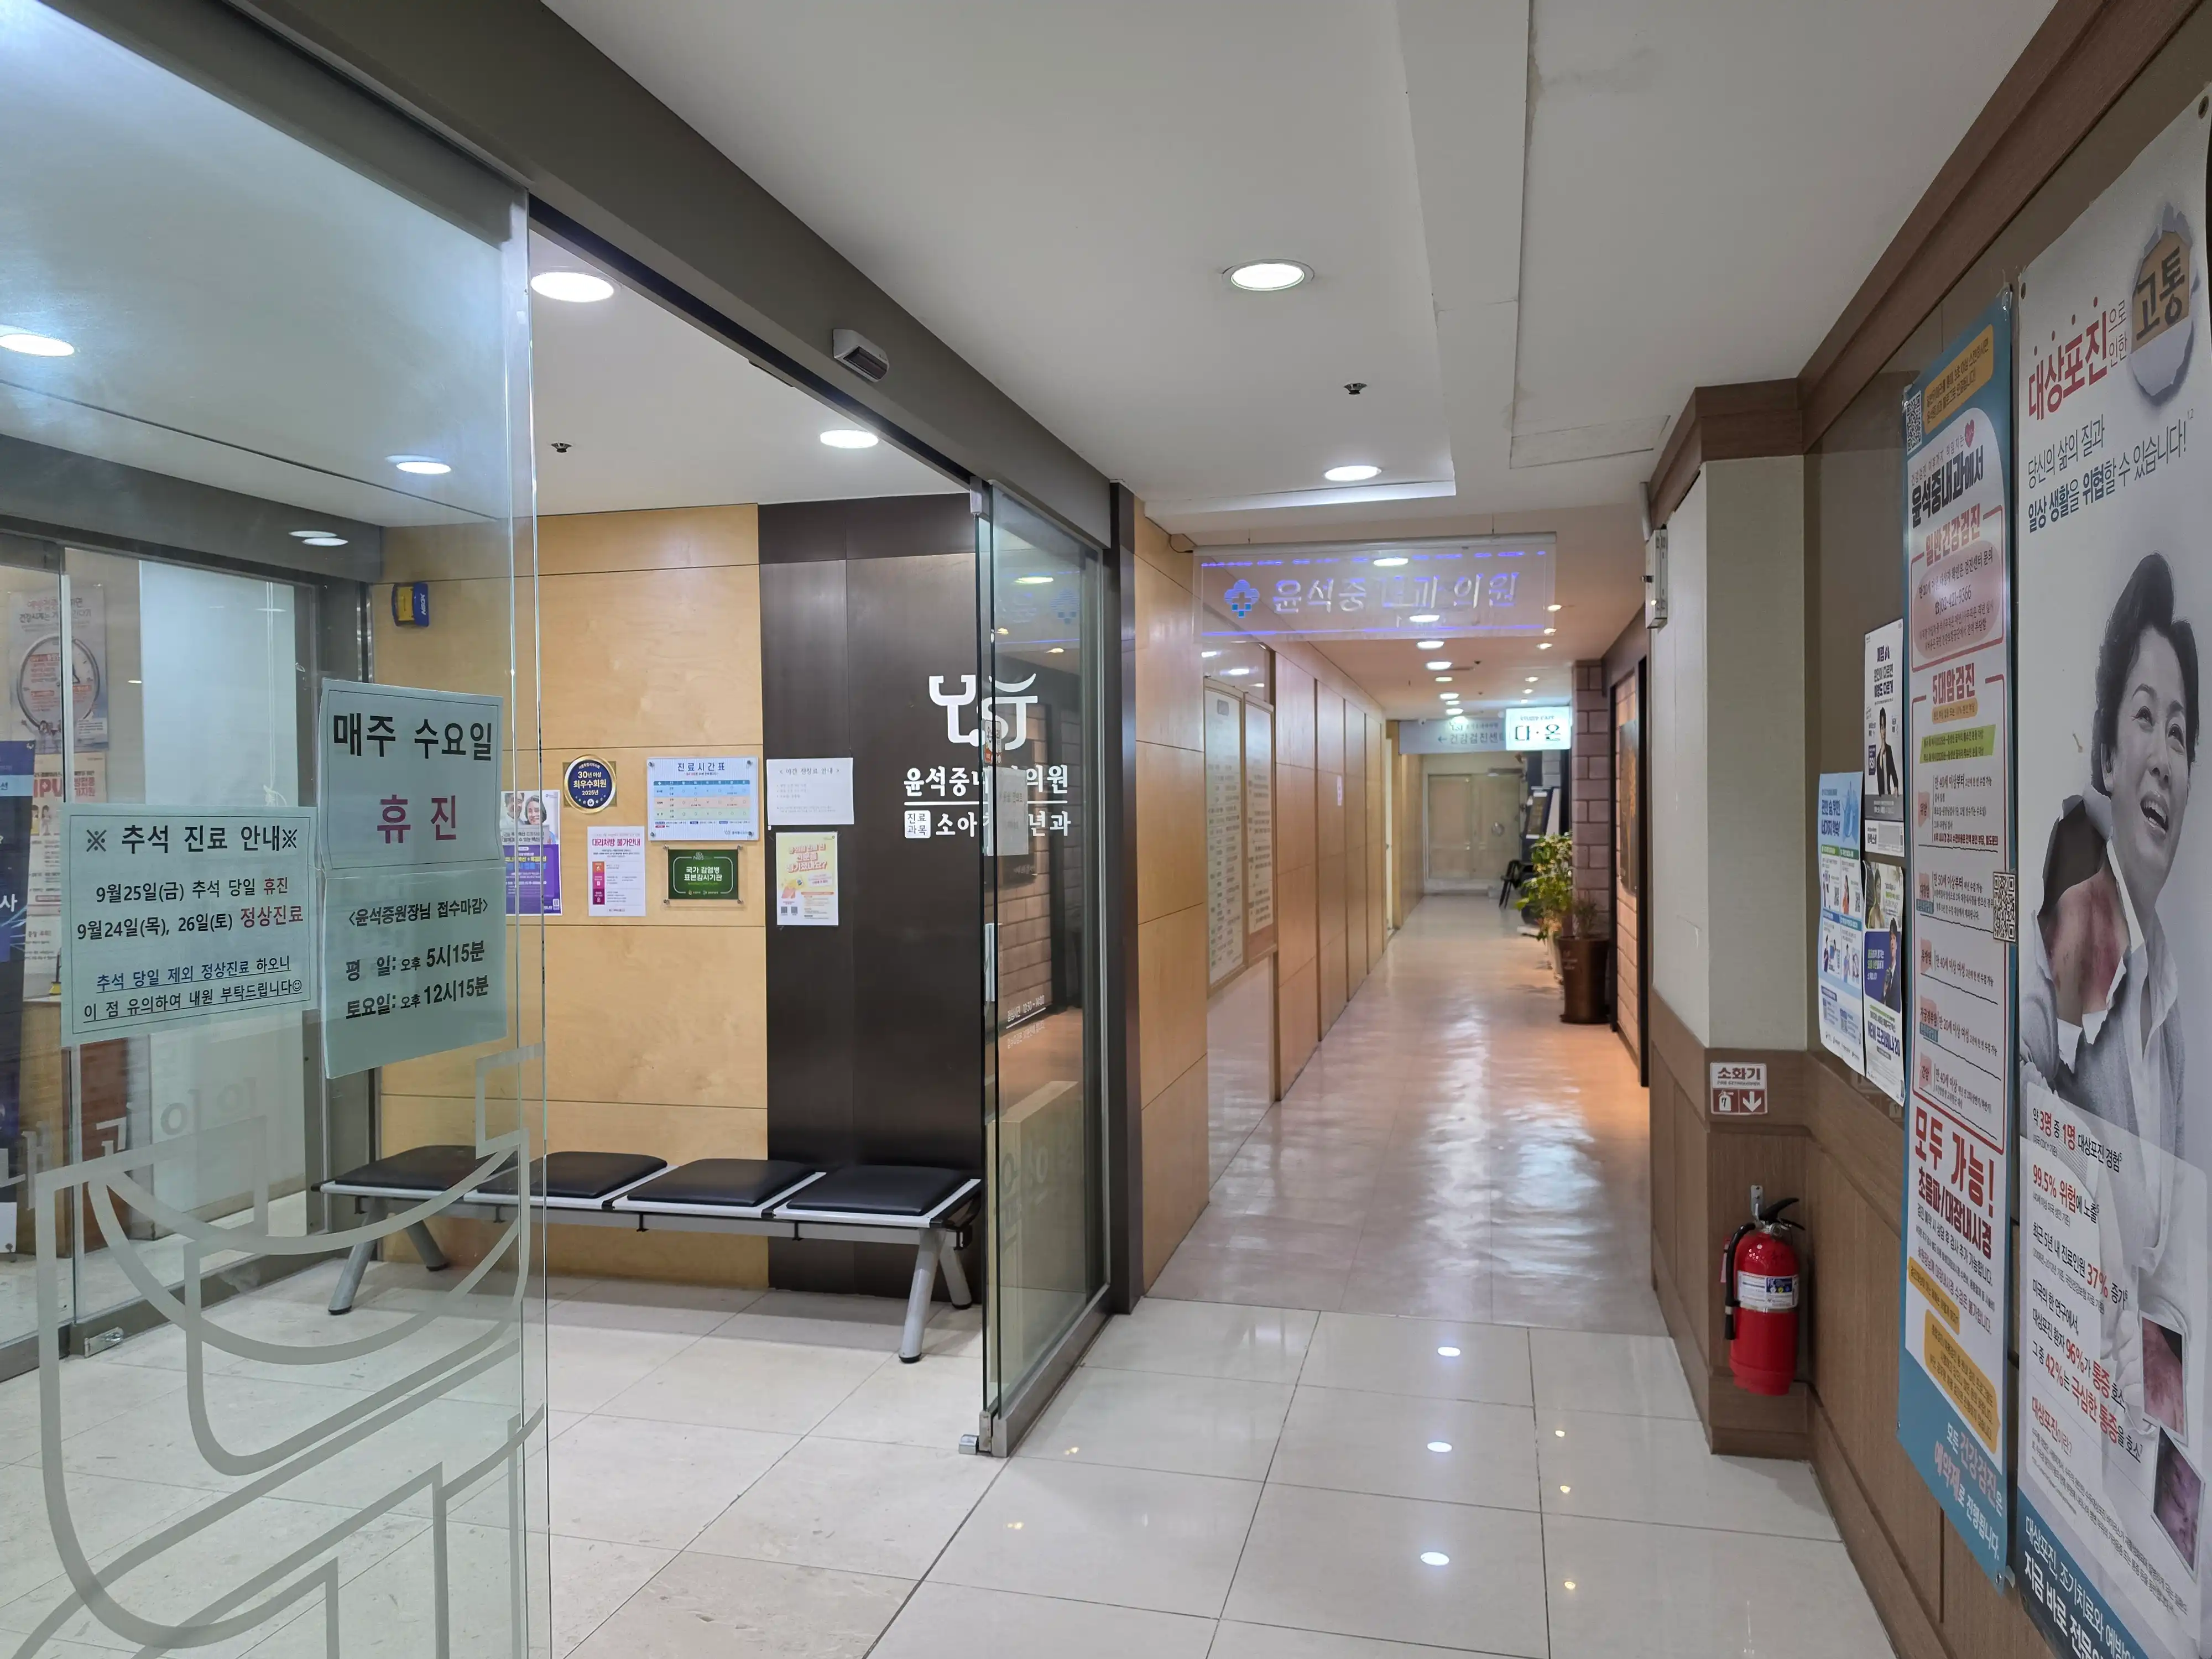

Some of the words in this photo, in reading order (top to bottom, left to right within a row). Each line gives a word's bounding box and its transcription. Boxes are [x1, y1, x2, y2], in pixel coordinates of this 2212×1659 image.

[2135, 246, 2185, 341] 고통
[2109, 333, 2127, 369] 인한
[2028, 442, 2054, 492] 당신의
[2057, 428, 2078, 474] 삶의
[2081, 411, 2105, 459] 질과
[1912, 437, 1983, 530] 윤석중내과에서
[2028, 494, 2046, 534] 일상
[2049, 475, 2079, 524] 생활을
[2082, 455, 2116, 508] 위협할
[2119, 451, 2130, 489] 수
[1926, 502, 1980, 567] 일반건강검진
[1933, 662, 1975, 705] 5대암검진
[333, 713, 396, 757] 매주
[414, 719, 492, 761] 수요일
[573, 779, 607, 789] 최우수회원
[1949, 773, 1964, 789] 이상부터
[122, 825, 169, 854] 추석
[184, 826, 228, 852] 진료
[907, 813, 927, 822] 진료
[907, 825, 927, 834] 과목
[96, 881, 184, 903] 9월25일(금)
[192, 880, 220, 898] 추석
[229, 878, 255, 897] 당일
[264, 877, 288, 895] 휴진
[1947, 874, 1963, 891] 이상부터
[77, 916, 169, 940] 9월24일(목),
[179, 914, 232, 932] 26일(토)
[241, 905, 303, 928] 정상진료
[97, 973, 124, 992] 추석
[133, 969, 159, 987] 당일
[168, 966, 194, 983] 제외
[201, 961, 250, 979] 정상진료
[256, 955, 290, 971] 하오니
[401, 957, 420, 971] 오후
[426, 940, 484, 967] 5시15분
[84, 1003, 97, 1020] 이
[106, 1001, 118, 1018] 점
[127, 992, 181, 1015] 유의하여
[189, 989, 213, 1005] 내원
[220, 979, 292, 1001] 부탁드립니다
[346, 993, 396, 1019] 토요일:
[400, 994, 420, 1009] 오후
[424, 975, 488, 1004] 12시15분
[1718, 1067, 1761, 1081] 소화기
[2033, 1105, 2038, 1127] 약
[2039, 1107, 2052, 1138] 3명
[2054, 1118, 2059, 1141] 중
[2063, 1119, 2075, 1154] 1명
[2078, 1130, 2104, 1166] 대상포진
[1915, 1105, 1943, 1176] 모두
[1950, 1131, 1994, 1220] 가능!
[1918, 1164, 1992, 1262] 초음파/대장내시경
[2033, 1162, 2056, 1200] 99.5%
[2059, 1177, 2081, 1220] 위험에
[2033, 1220, 2043, 1246] 최근
[2044, 1228, 2053, 1254] 5년
[2054, 1237, 2060, 1260] 내
[2061, 1242, 2085, 1280] 진료인원
[2087, 1261, 2108, 1300] 37%
[2033, 1277, 2047, 1307] 미국의
[2048, 1291, 2054, 1313] 한
[2033, 1305, 2052, 1341] 대상포진
[2054, 1325, 2064, 1353] 환자
[2066, 1335, 2091, 1383] 96%가
[2092, 1358, 2110, 1402] 통증
[2032, 1392, 2072, 1460] 대상포진이란?
[2045, 1350, 2070, 1397] 42%는
[2072, 1375, 2097, 1426] 극심한
[2099, 1402, 2124, 1454] 통증을
[1934, 1436, 1965, 1512] 예약제로
[1947, 1418, 1958, 1457] 모든
[1960, 1428, 2002, 1520] 건강검진은
[2025, 1548, 2043, 1605] 지금
[2046, 1578, 2068, 1640] 바로
[2059, 1555, 2104, 1645] 조기치료와
